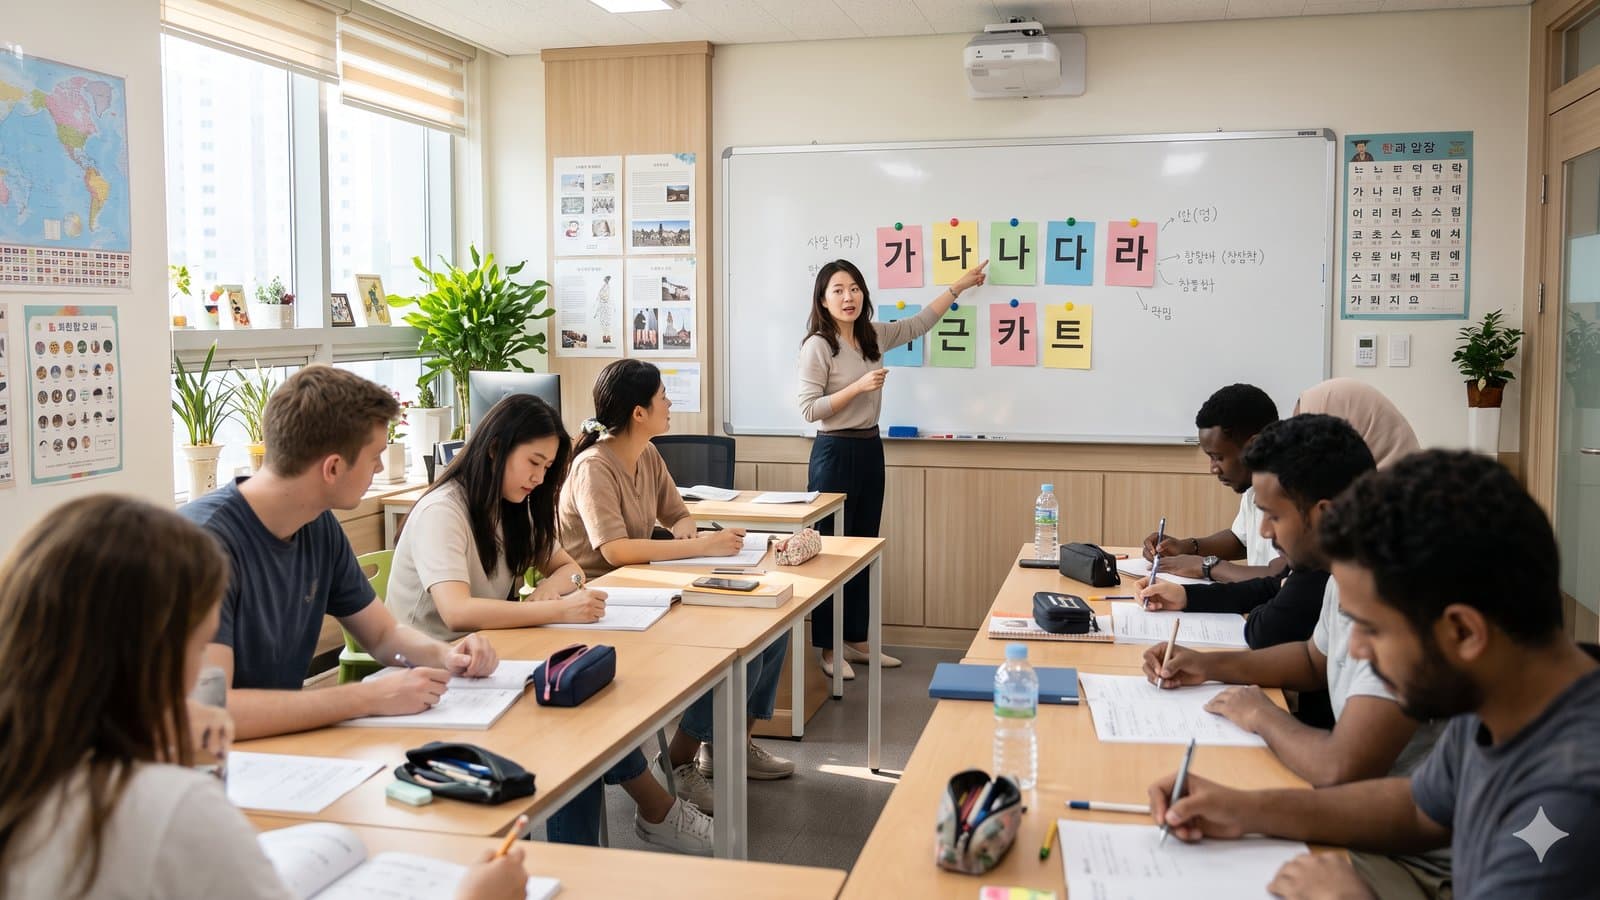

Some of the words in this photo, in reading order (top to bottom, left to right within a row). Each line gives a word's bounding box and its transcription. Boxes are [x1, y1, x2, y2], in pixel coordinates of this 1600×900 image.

[1353, 187, 1364, 197] 가
[1372, 186, 1383, 197] 나
[1392, 186, 1402, 196] 리
[1352, 208, 1363, 219] 어
[1411, 207, 1423, 217] 소
[1431, 207, 1442, 217] 스
[1391, 230, 1402, 239] 스
[1410, 229, 1421, 239] 토
[884, 238, 916, 273] 가
[941, 235, 972, 270] 나
[999, 235, 1030, 270] 나
[1055, 235, 1087, 271] 다
[1115, 235, 1149, 271] 라
[1351, 251, 1362, 262] 우
[1390, 251, 1402, 262] 바
[1351, 273, 1362, 283] 스
[1351, 295, 1362, 305] 가
[1389, 295, 1400, 305] 지
[938, 318, 970, 352] 근
[998, 316, 1030, 351] 카
[1051, 320, 1084, 349] 트
